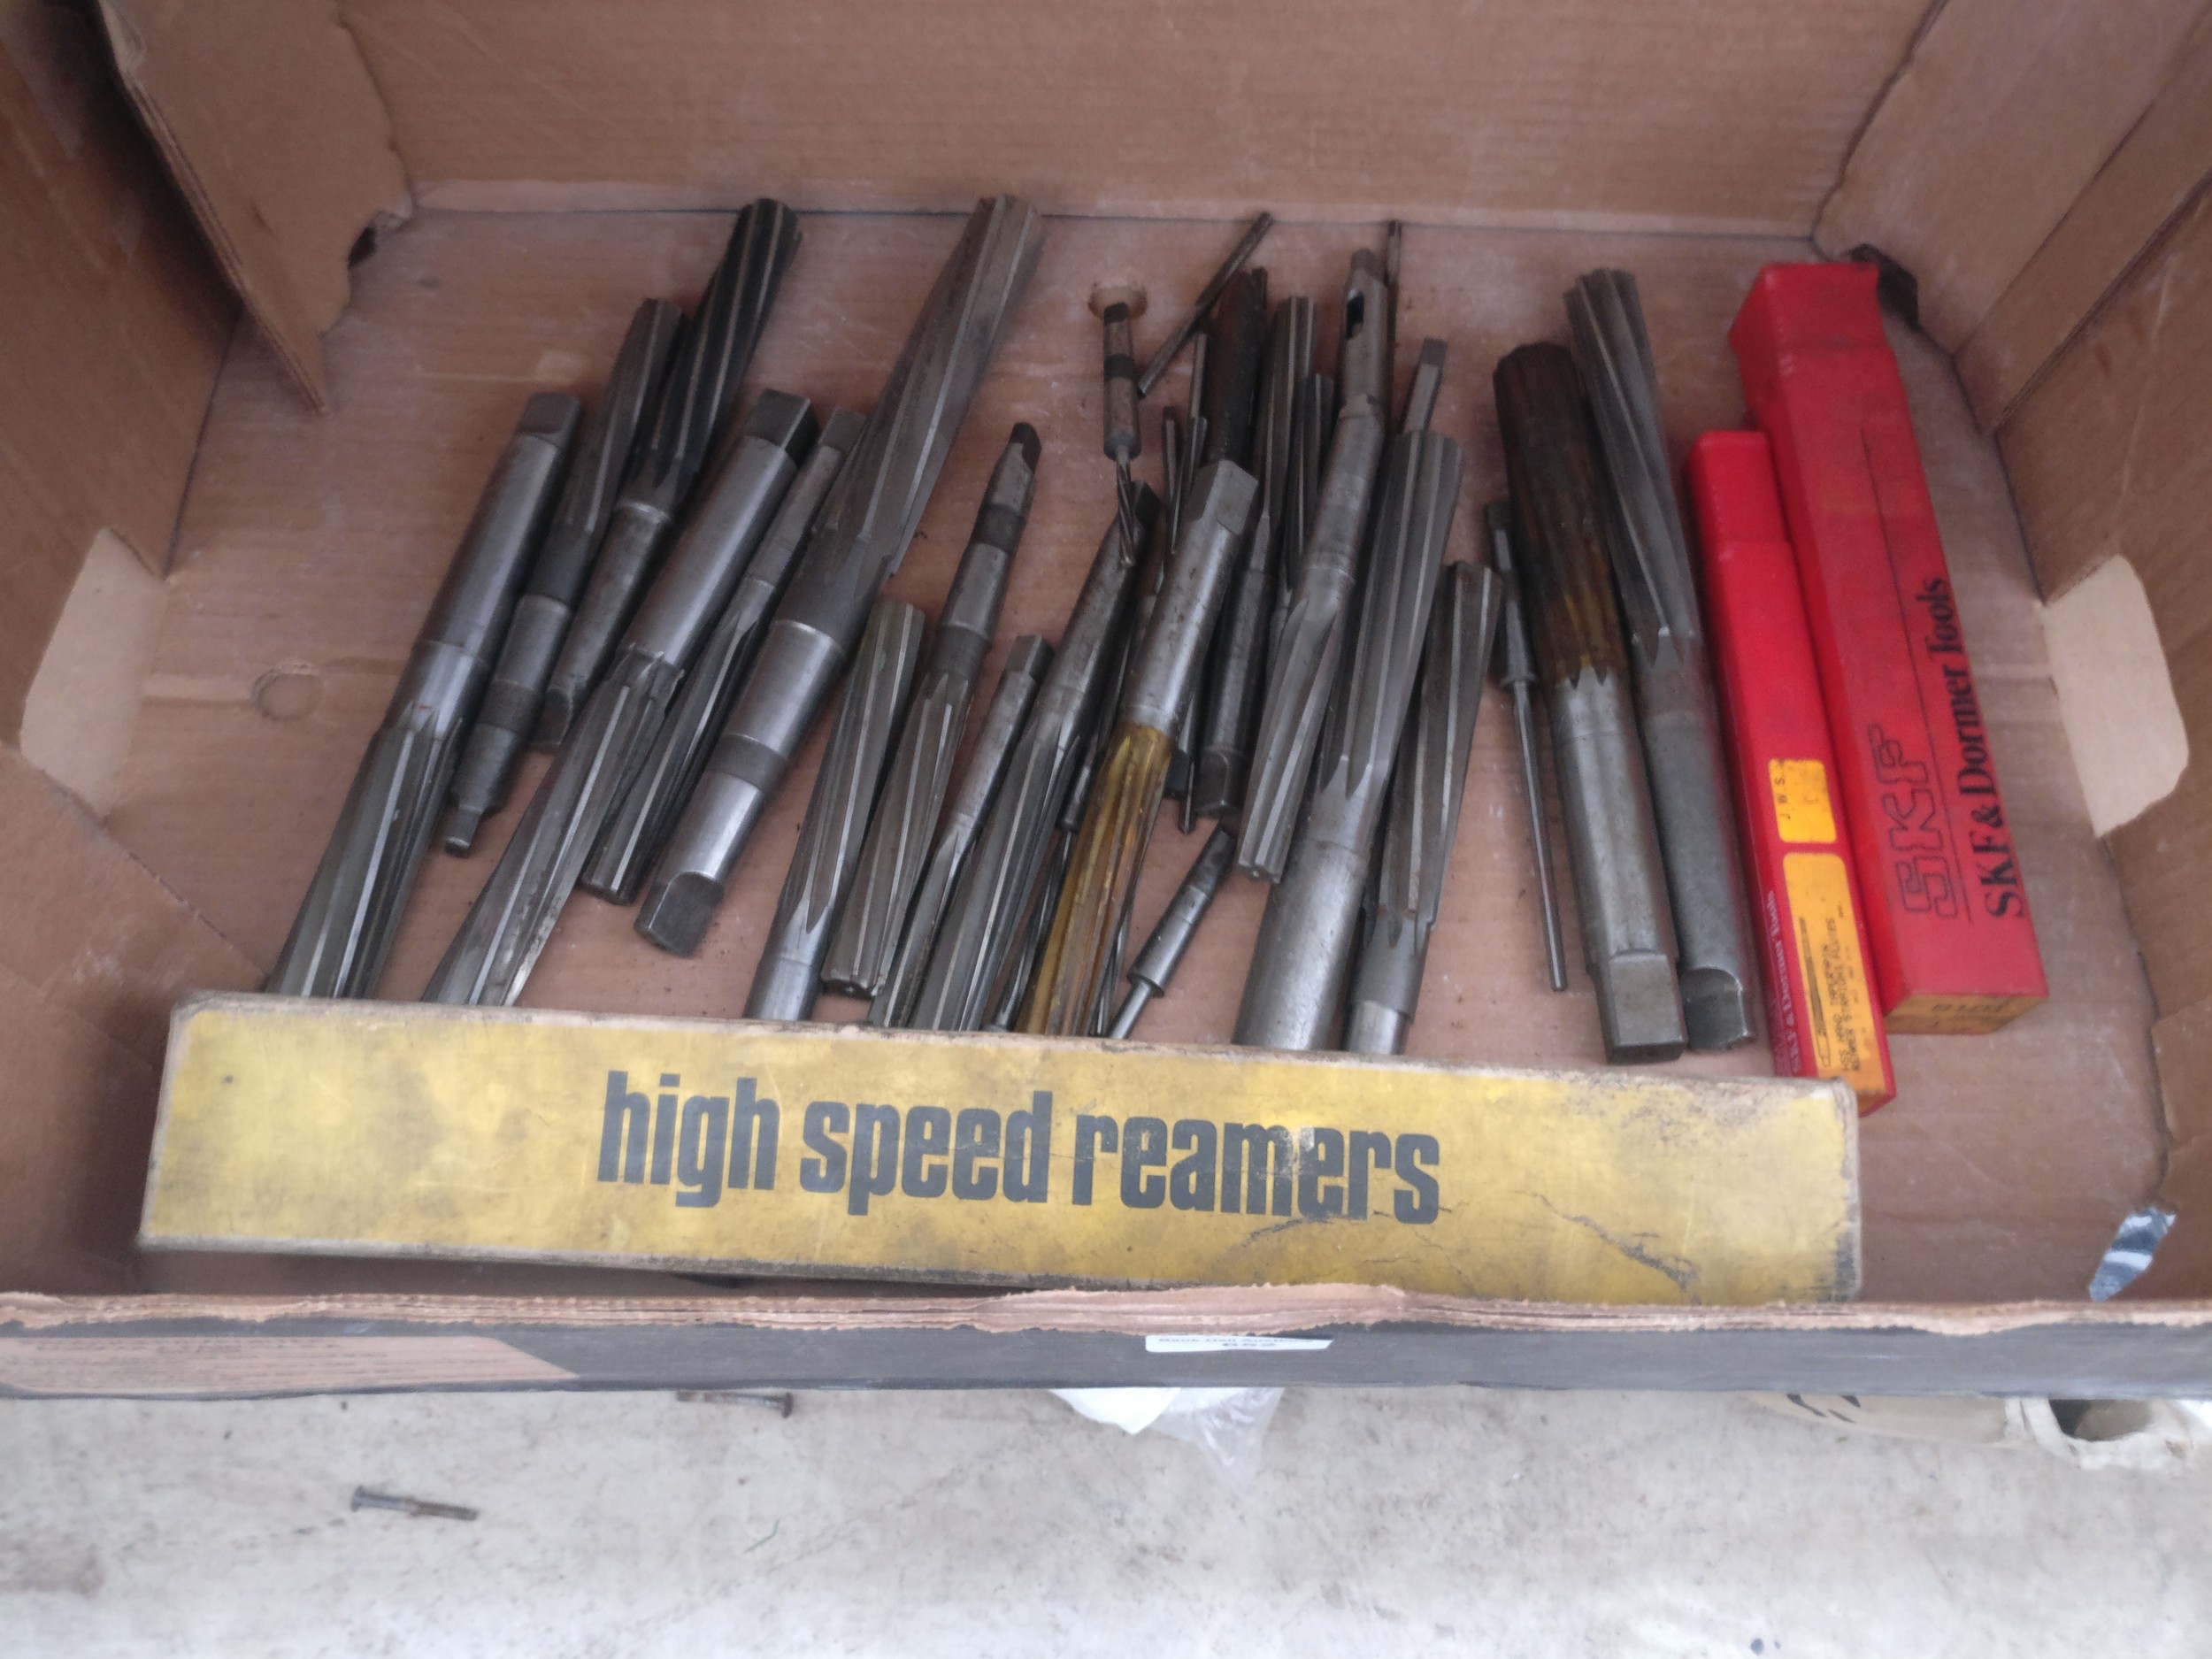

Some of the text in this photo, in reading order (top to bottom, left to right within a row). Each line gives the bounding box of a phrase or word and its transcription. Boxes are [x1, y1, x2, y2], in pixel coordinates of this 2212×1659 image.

[1867, 723, 1958, 918] SKF
[1916, 578, 2024, 918] SKF & Dormer Tools
[598, 1071, 1440, 1225] high speed reamers
